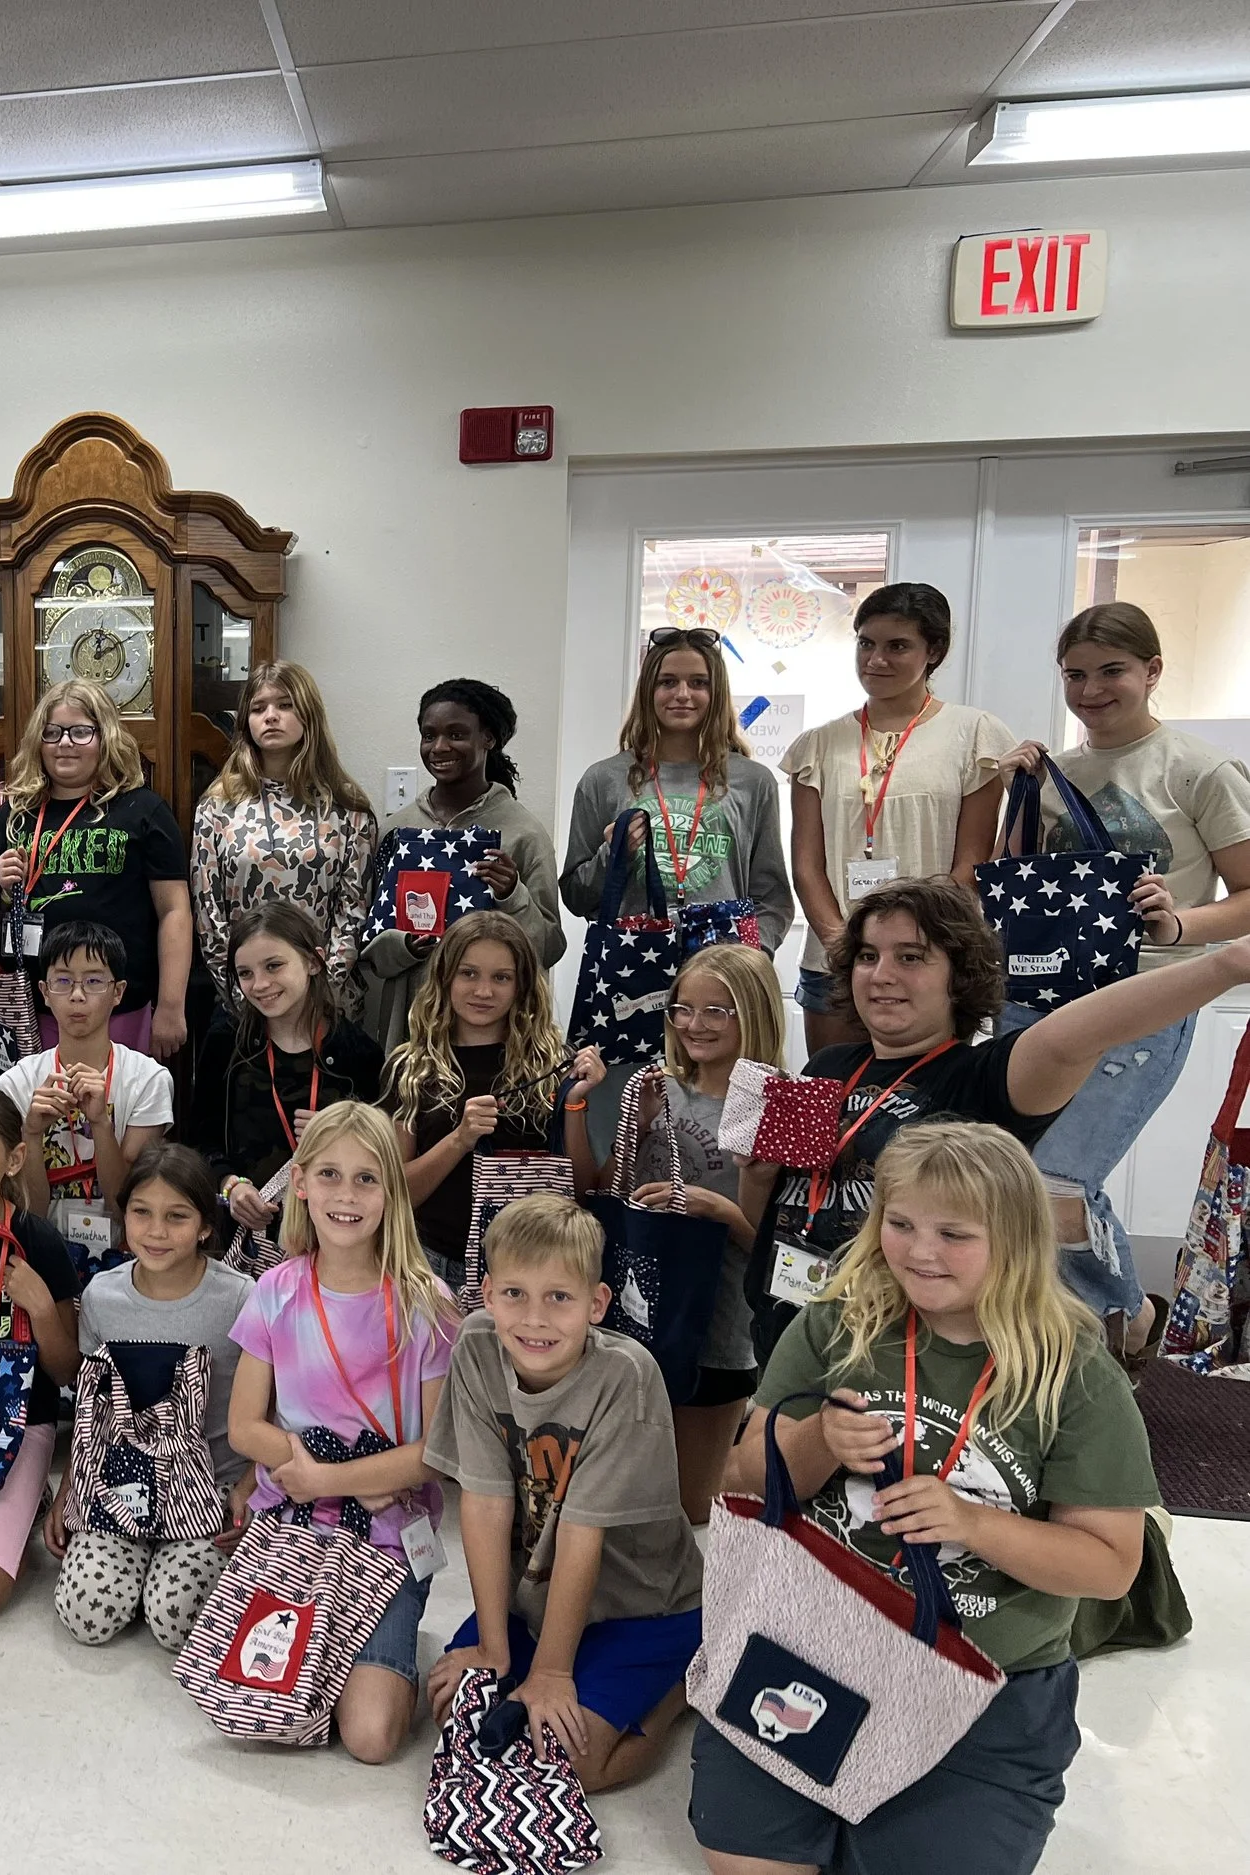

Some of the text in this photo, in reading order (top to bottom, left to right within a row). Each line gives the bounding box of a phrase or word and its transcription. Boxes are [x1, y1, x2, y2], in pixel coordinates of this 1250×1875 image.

[981, 234, 1090, 316] EXIT
[653, 829, 732, 859] RTLAND
[1017, 955, 1053, 963] UNITED
[1011, 964, 1058, 973] WE STAND
[70, 1227, 108, 1242] Jonathan
[885, 1390, 918, 1405] TH
[973, 1423, 991, 1441] IN
[989, 1437, 1015, 1465] HIS
[951, 1592, 997, 1605] JESUS
[957, 1599, 997, 1612] OVES
[249, 1636, 286, 1656] America
[792, 1683, 822, 1709] USA
